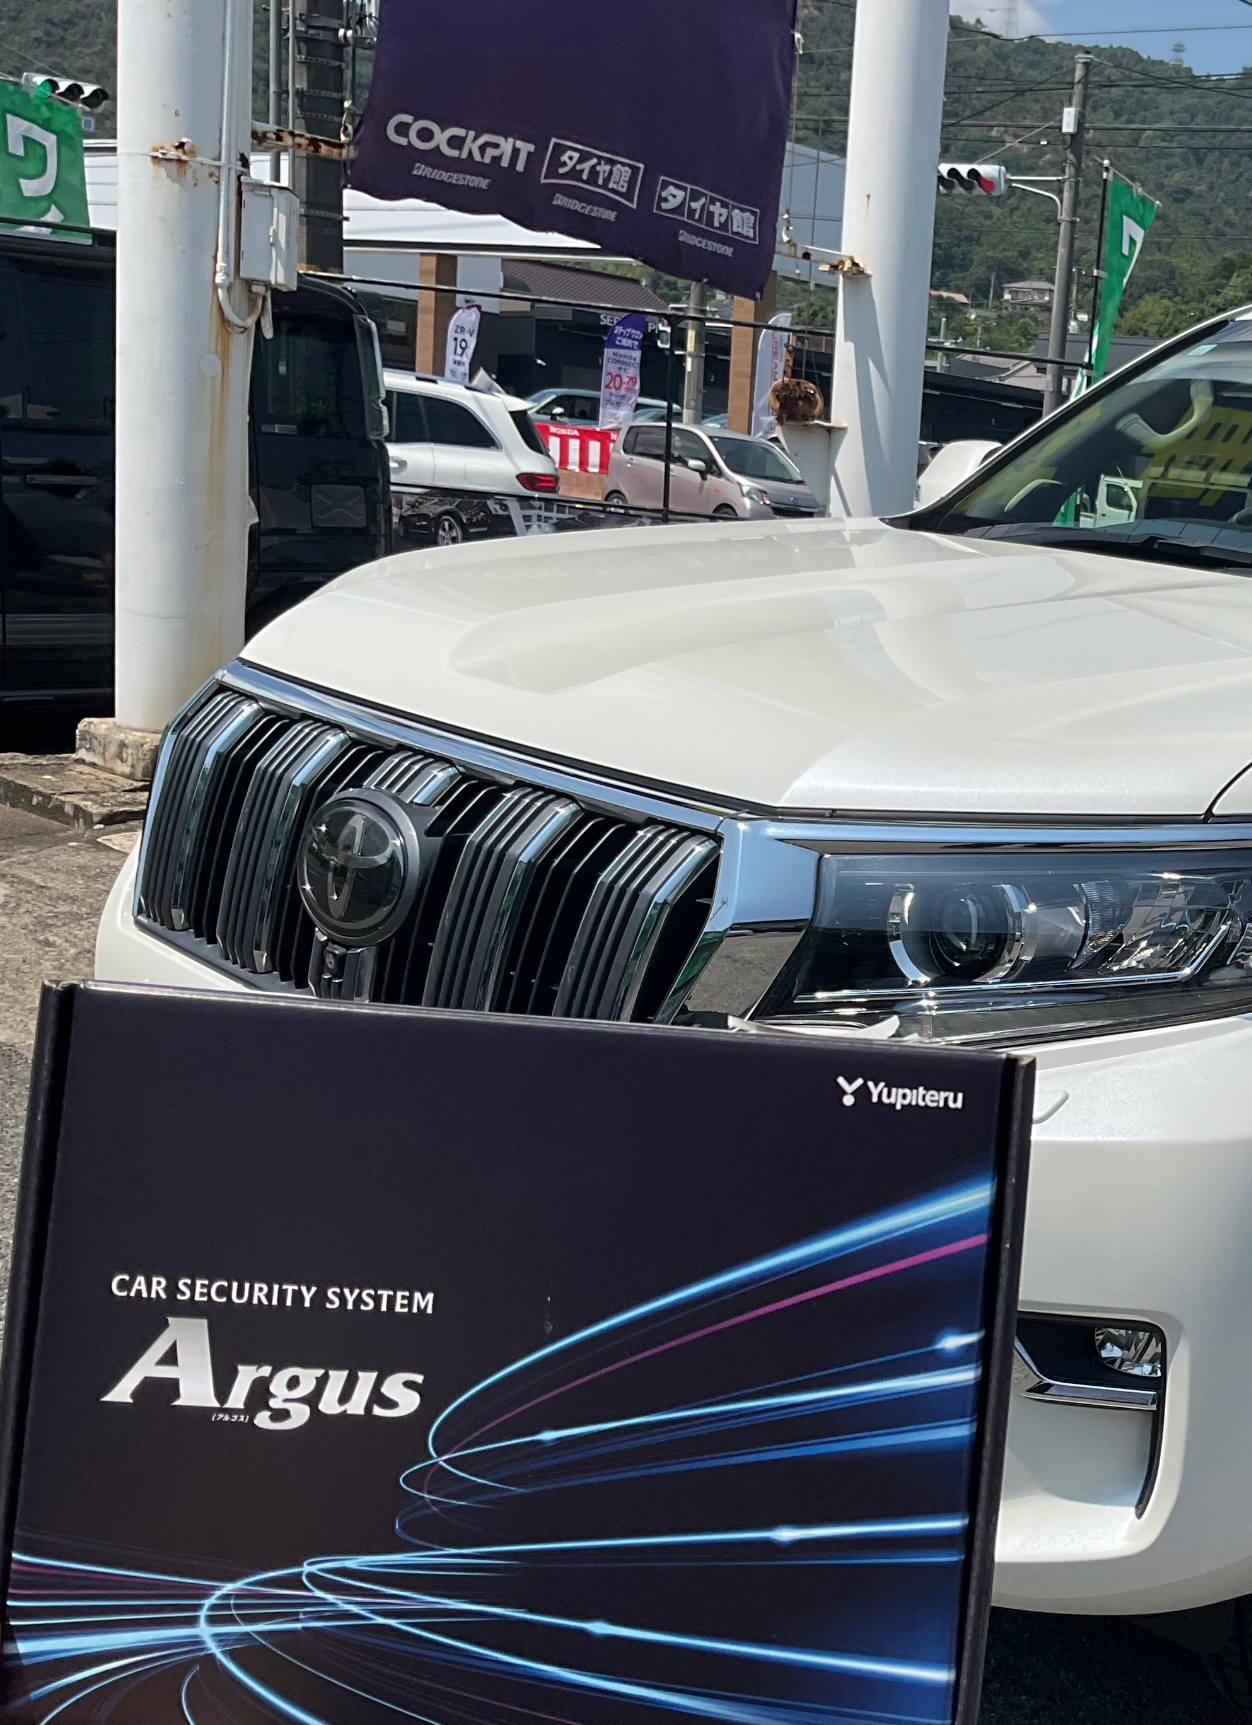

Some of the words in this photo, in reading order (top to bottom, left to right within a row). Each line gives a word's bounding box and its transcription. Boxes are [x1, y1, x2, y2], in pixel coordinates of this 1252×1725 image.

[386, 113, 535, 173] COCKPIT
[412, 162, 492, 190] BRIDGESTONE
[557, 149, 631, 192] タイヤ館
[552, 192, 617, 222] BRIDGESTONE
[660, 184, 756, 239] タイヤ館
[866, 1080, 964, 1111] Yupiteru
[111, 1275, 167, 1299] CAR
[176, 1279, 318, 1308] SECURITY
[325, 1288, 435, 1314] SYSTEM
[100, 1316, 425, 1431] Argus
